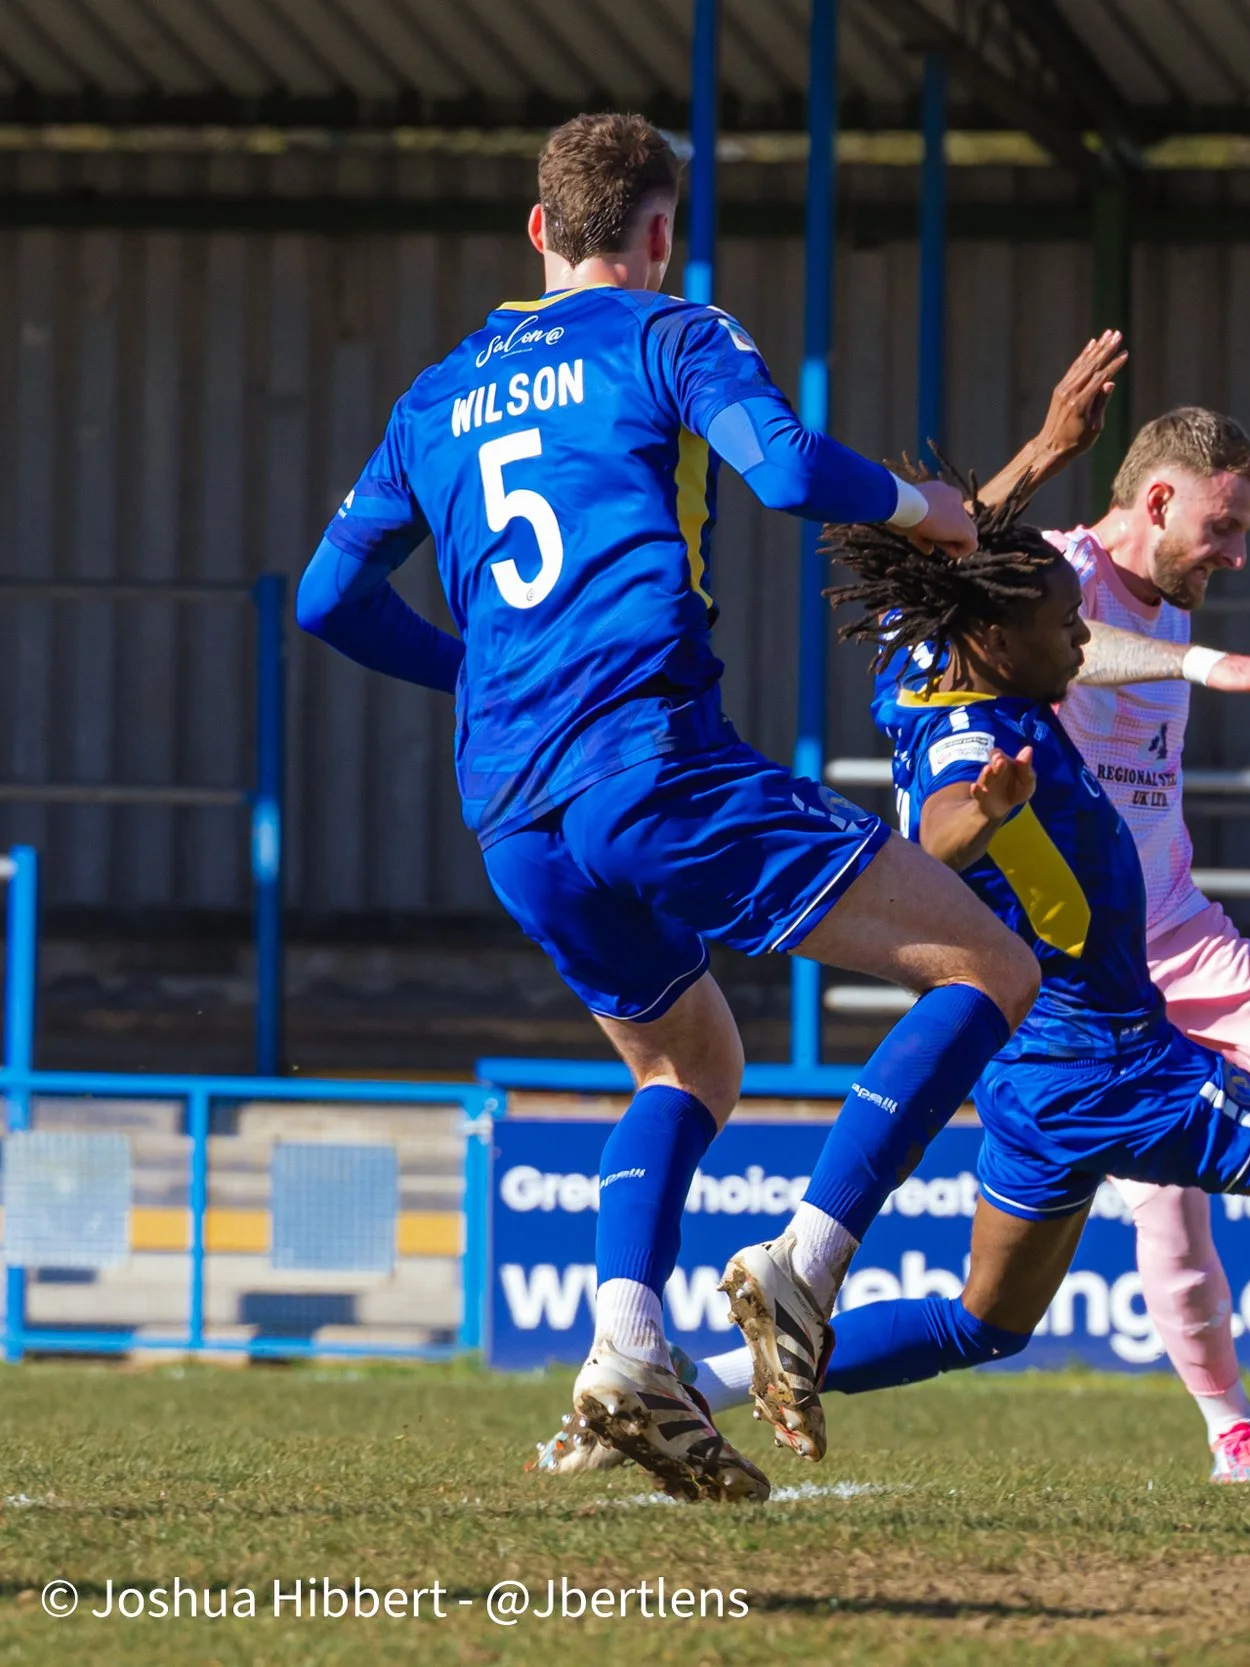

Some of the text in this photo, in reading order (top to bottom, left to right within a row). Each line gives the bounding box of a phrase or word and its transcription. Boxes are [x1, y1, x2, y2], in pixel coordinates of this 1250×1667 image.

[451, 358, 584, 438] WILSON
[478, 427, 564, 610] 5
[1097, 763, 1158, 787] REGIONAL
[500, 1165, 600, 1213] Gre
